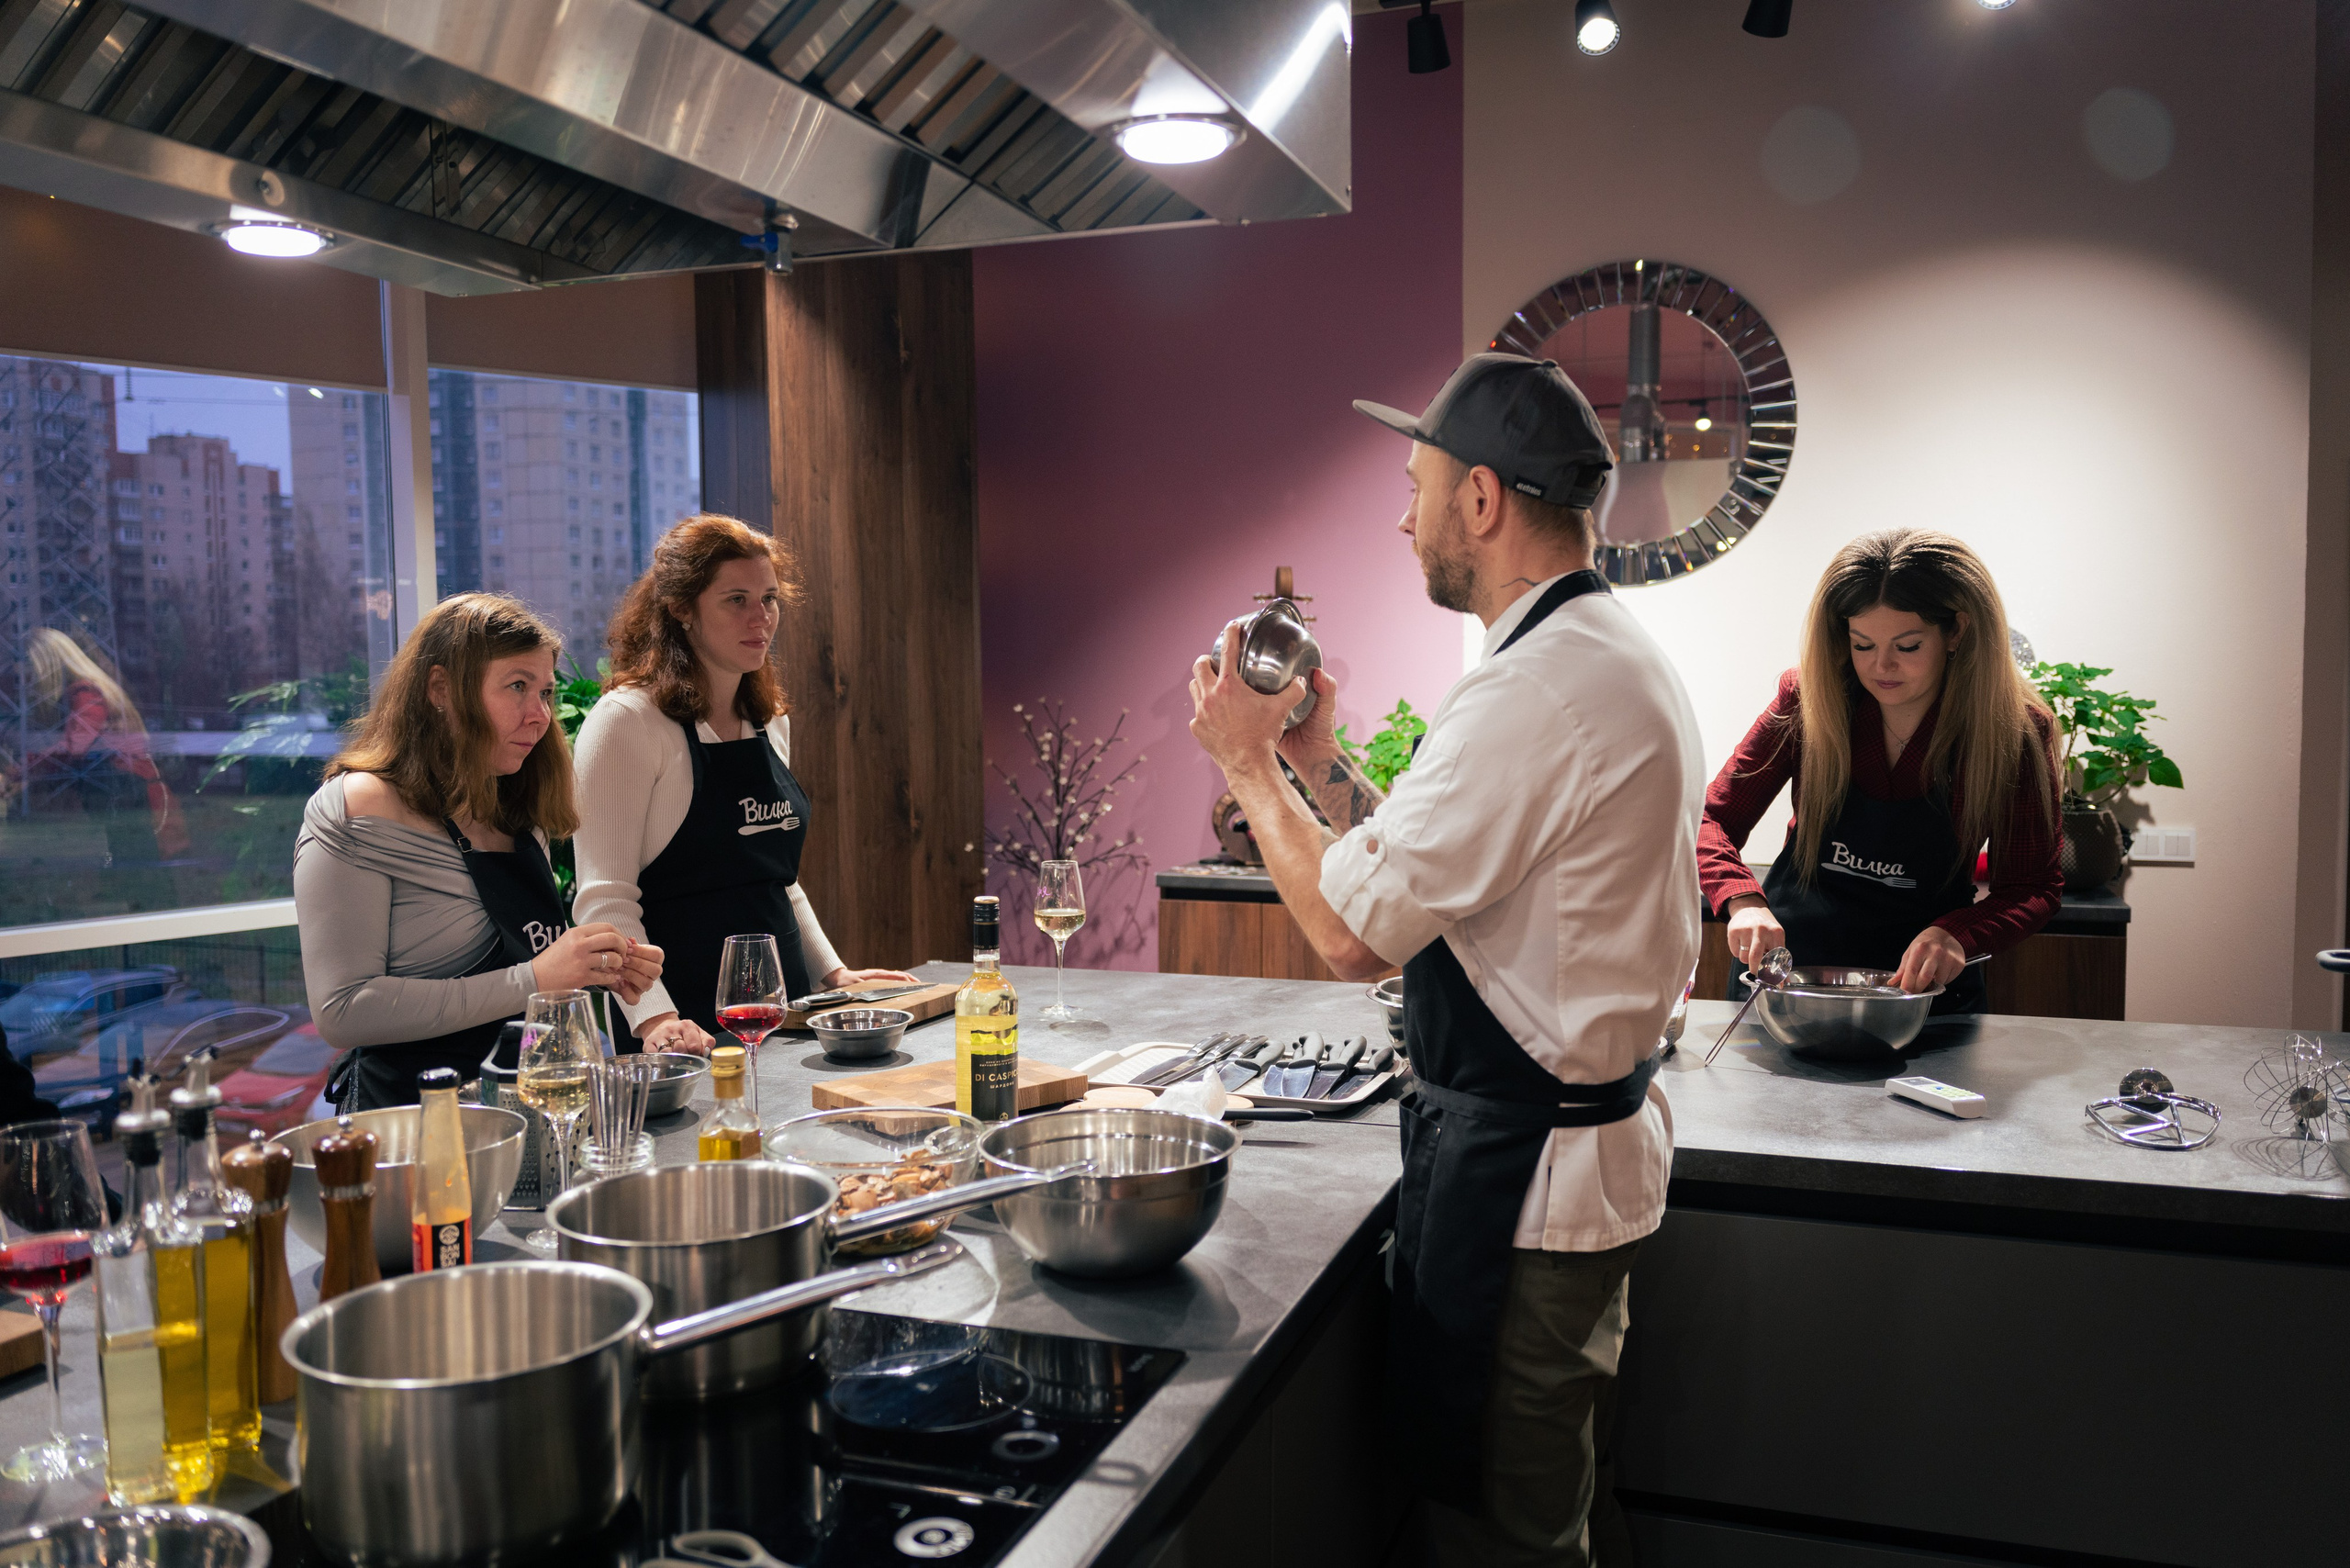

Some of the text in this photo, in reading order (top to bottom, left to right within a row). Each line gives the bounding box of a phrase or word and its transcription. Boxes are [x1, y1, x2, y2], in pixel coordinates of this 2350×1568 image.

[738, 797, 793, 823] Вилка
[1831, 841, 1906, 876] Вилка
[975, 1073, 985, 1081] DI
